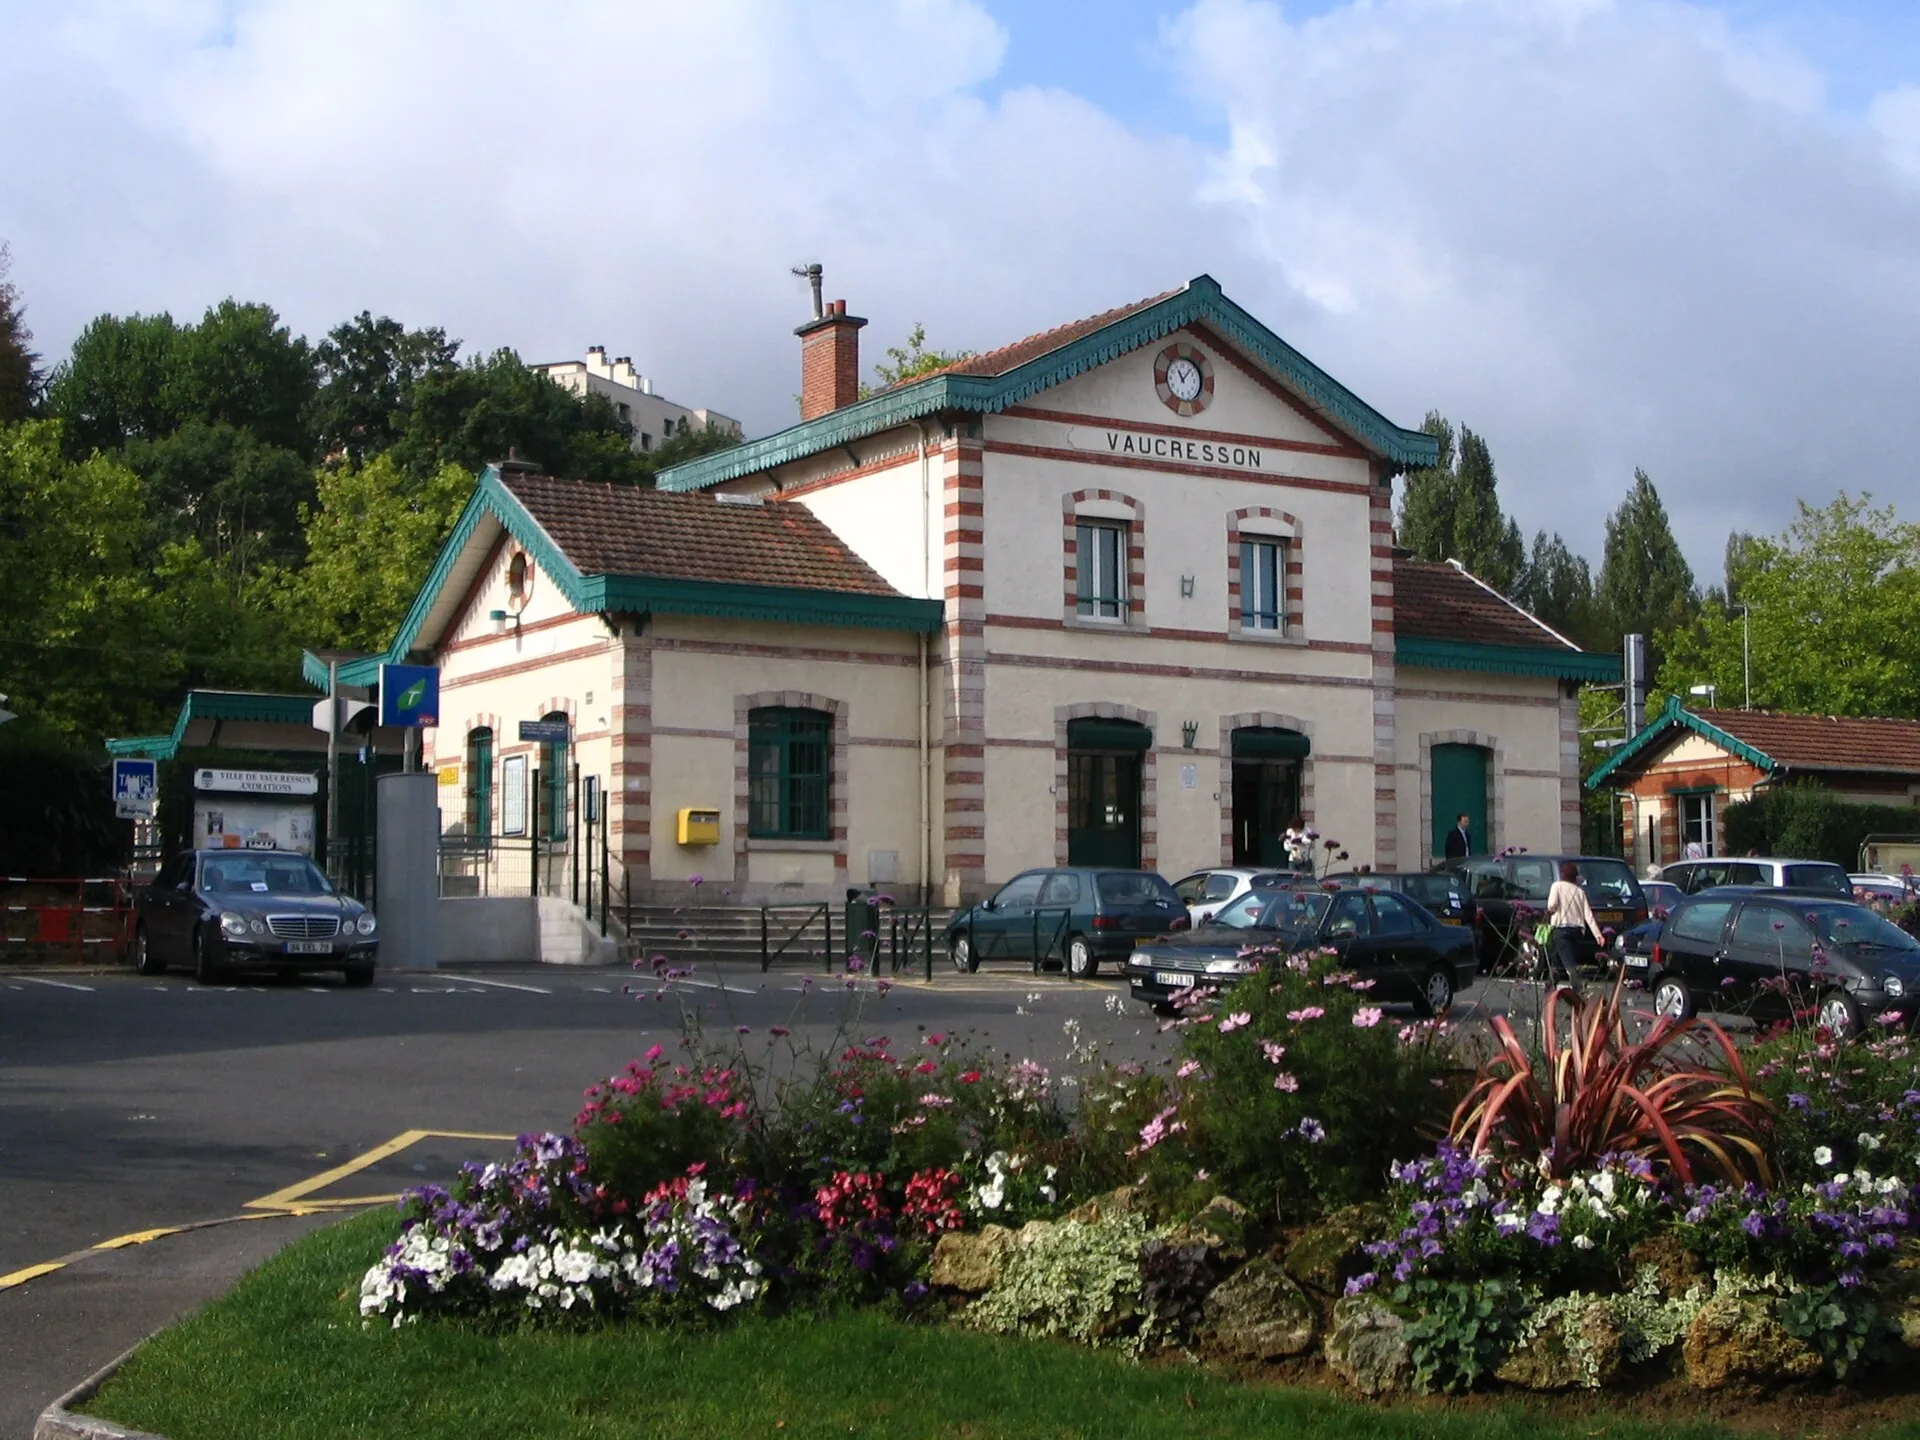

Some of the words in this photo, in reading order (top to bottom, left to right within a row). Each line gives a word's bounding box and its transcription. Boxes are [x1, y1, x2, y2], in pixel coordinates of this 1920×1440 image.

[1106, 432, 1261, 468] VAUCRESSON
[408, 690, 420, 706] T
[119, 774, 151, 788] TAIS
[220, 772, 243, 780] VILLE
[246, 773, 256, 781] DE
[260, 774, 312, 784] VAUCRESSON
[240, 782, 292, 792] ANIMATIONS
